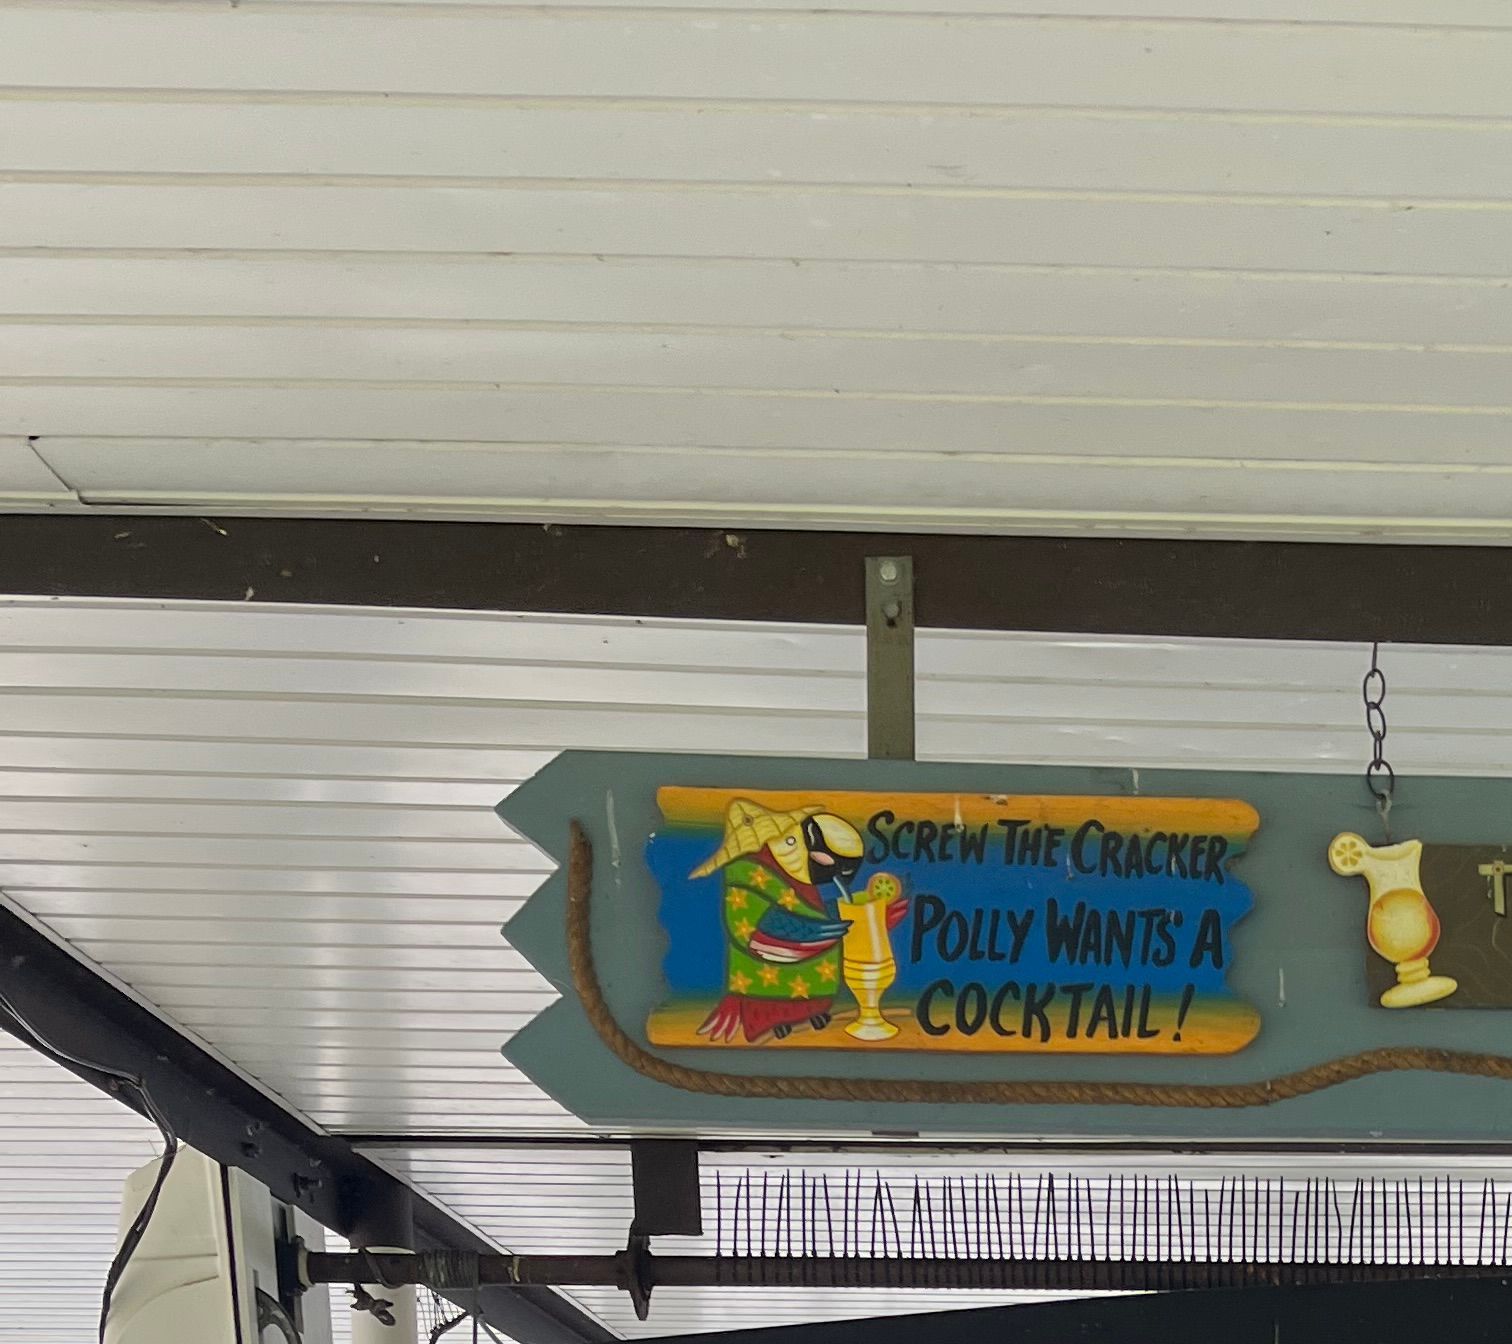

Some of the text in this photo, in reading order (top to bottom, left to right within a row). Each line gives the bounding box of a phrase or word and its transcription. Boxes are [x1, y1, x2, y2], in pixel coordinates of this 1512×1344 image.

[866, 809, 1230, 885] SCREW THE CRACKER
[909, 895, 1036, 967] POLLY
[1189, 908, 1224, 970] A
